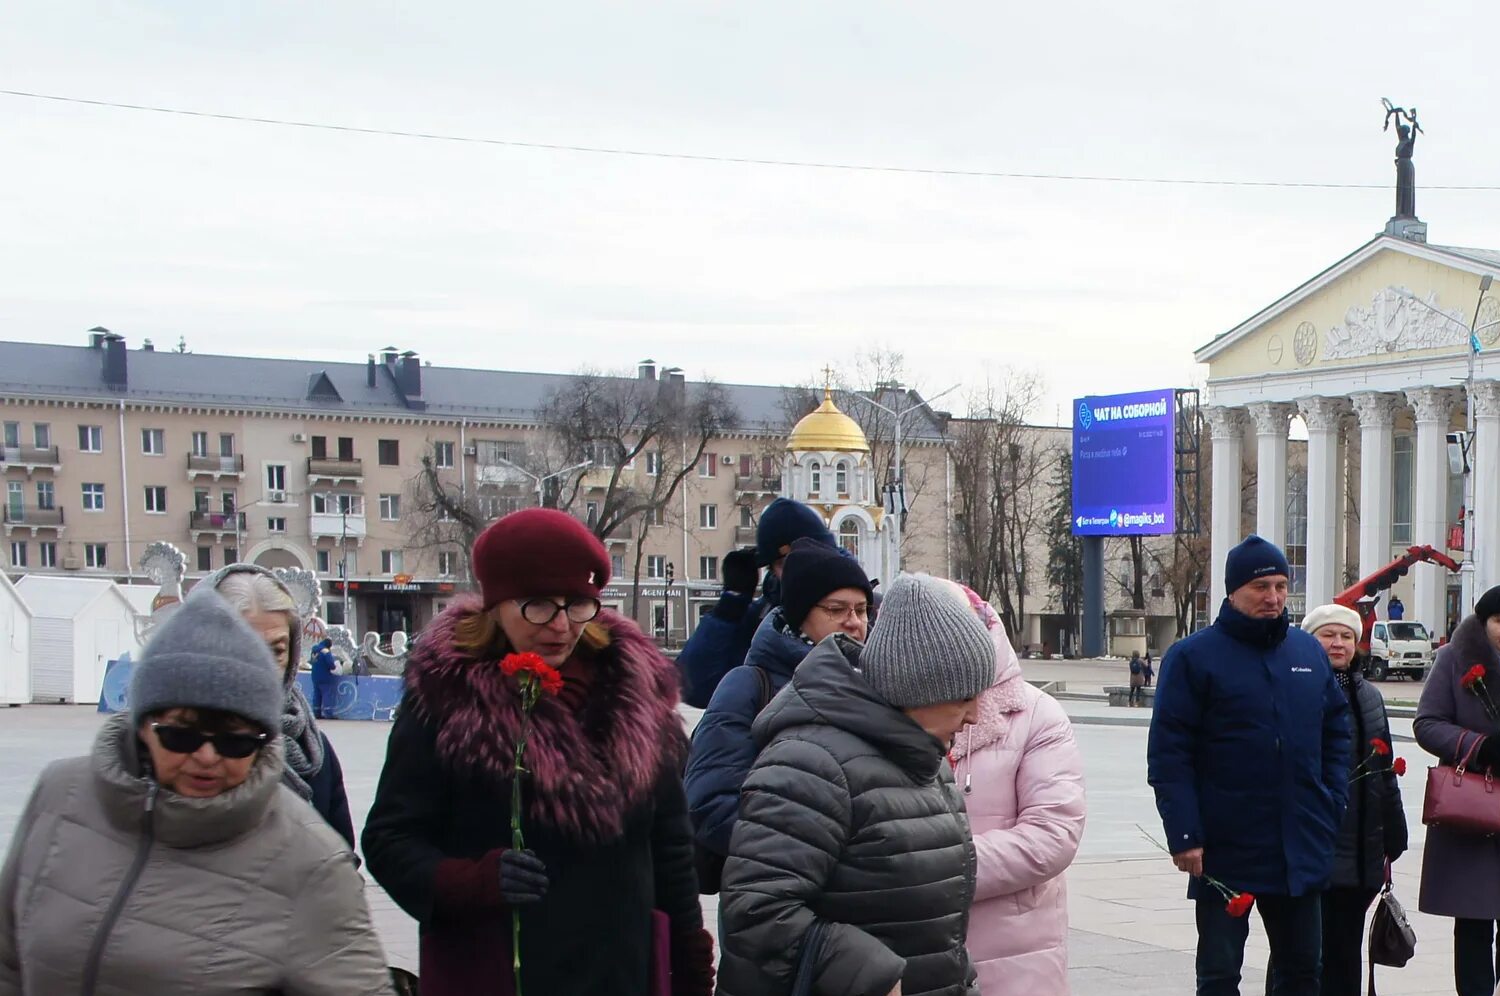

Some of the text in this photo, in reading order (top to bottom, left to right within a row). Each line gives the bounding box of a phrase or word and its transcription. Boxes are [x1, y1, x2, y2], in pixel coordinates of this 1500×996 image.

[1094, 397, 1167, 422] ЧАТ НА СОБОРНОЙ
[1123, 511, 1165, 528] @magiks_bot
